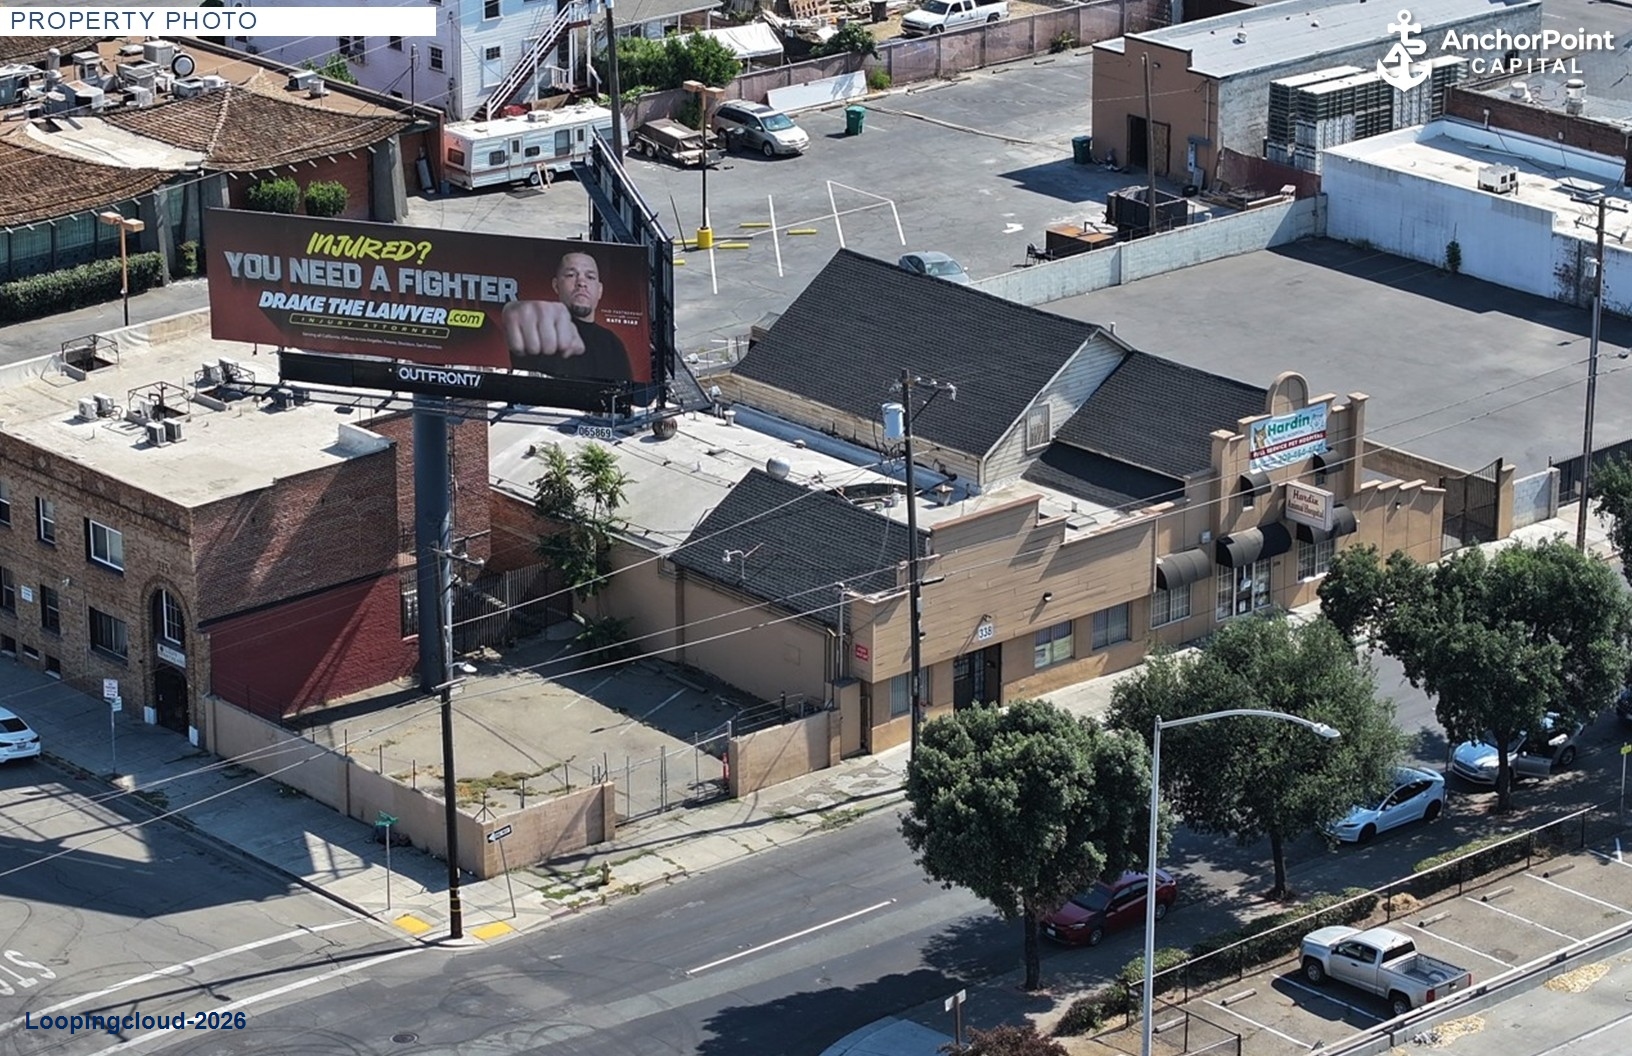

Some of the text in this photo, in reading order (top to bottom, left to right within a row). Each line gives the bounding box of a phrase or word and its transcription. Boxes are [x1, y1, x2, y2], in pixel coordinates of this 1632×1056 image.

[306, 232, 432, 265] INJURED?
[224, 251, 519, 303] YOU NEED A FIGHTER
[259, 290, 325, 313] DRAKE
[327, 297, 366, 316] THE
[301, 317, 438, 335] INJURY ATTORNEY
[578, 426, 611, 438] 065869
[1268, 414, 1310, 436] Hardin
[1266, 443, 1288, 454] SERVICE
[1288, 440, 1299, 448] PET
[1298, 433, 1324, 445] HOSPITAL
[1293, 489, 1319, 505] Hardin
[980, 626, 992, 638] 338
